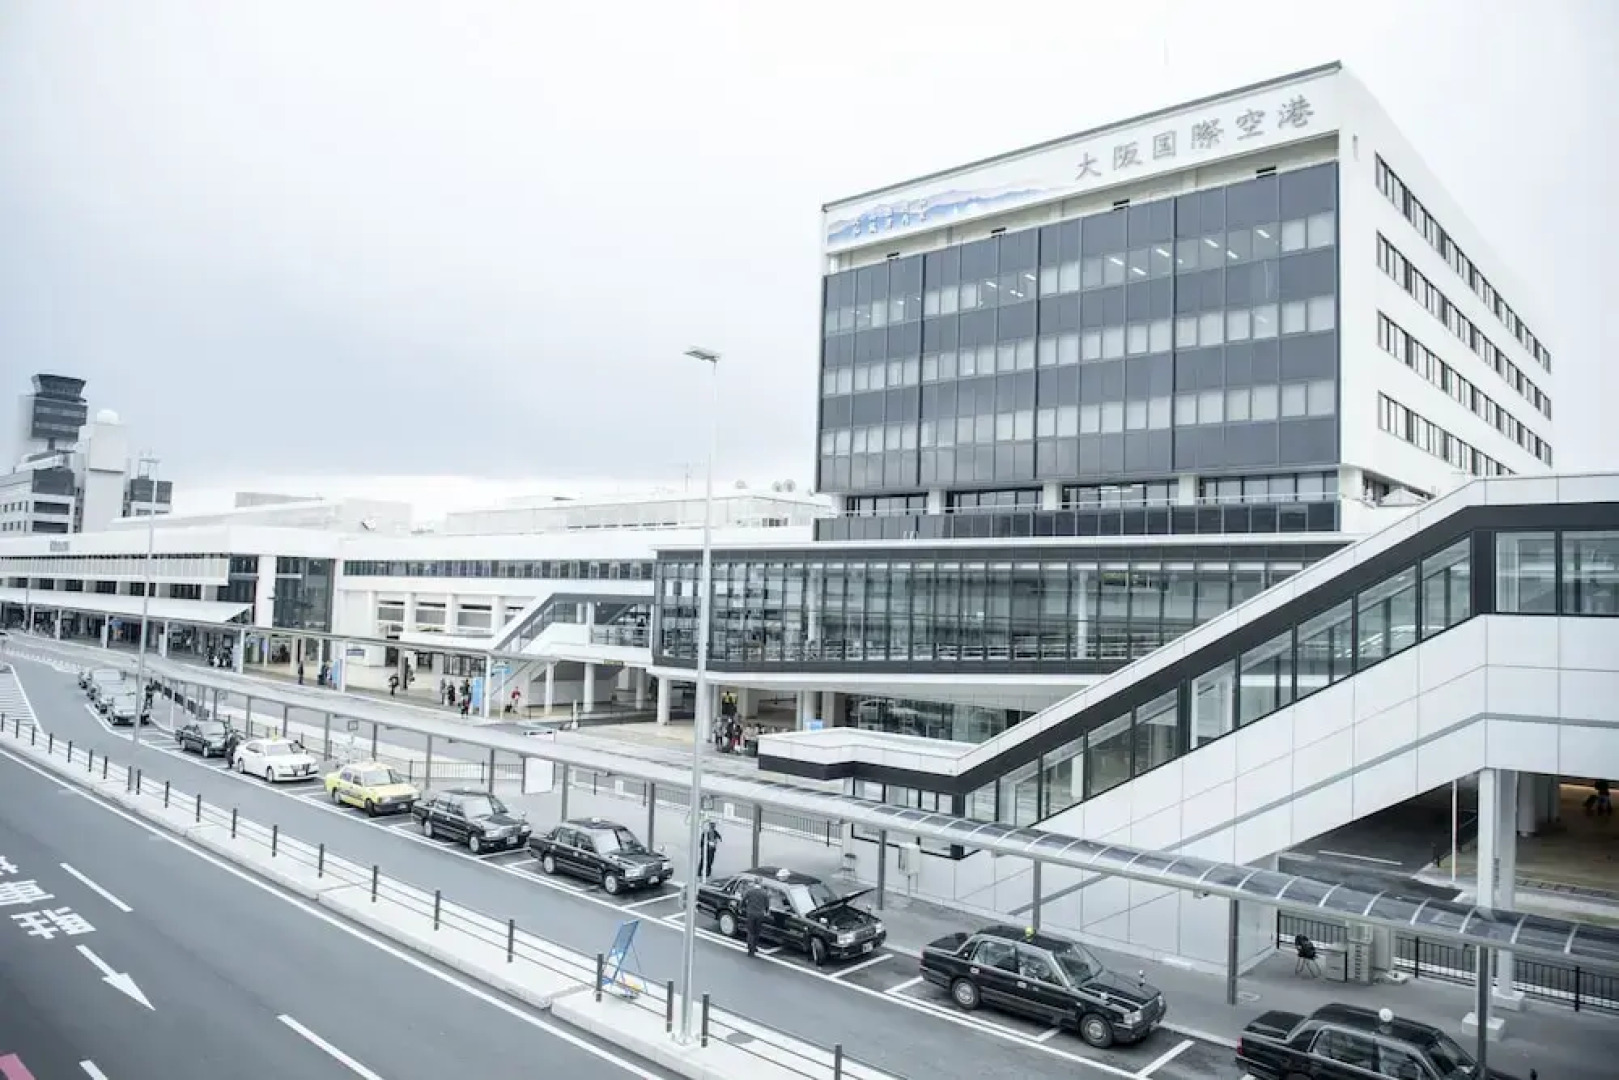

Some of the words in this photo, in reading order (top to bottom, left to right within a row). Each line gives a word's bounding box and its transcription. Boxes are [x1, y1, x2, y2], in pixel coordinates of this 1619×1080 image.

[1075, 95, 1314, 181] 大阪国際空港
[0, 855, 97, 939] 駐車
